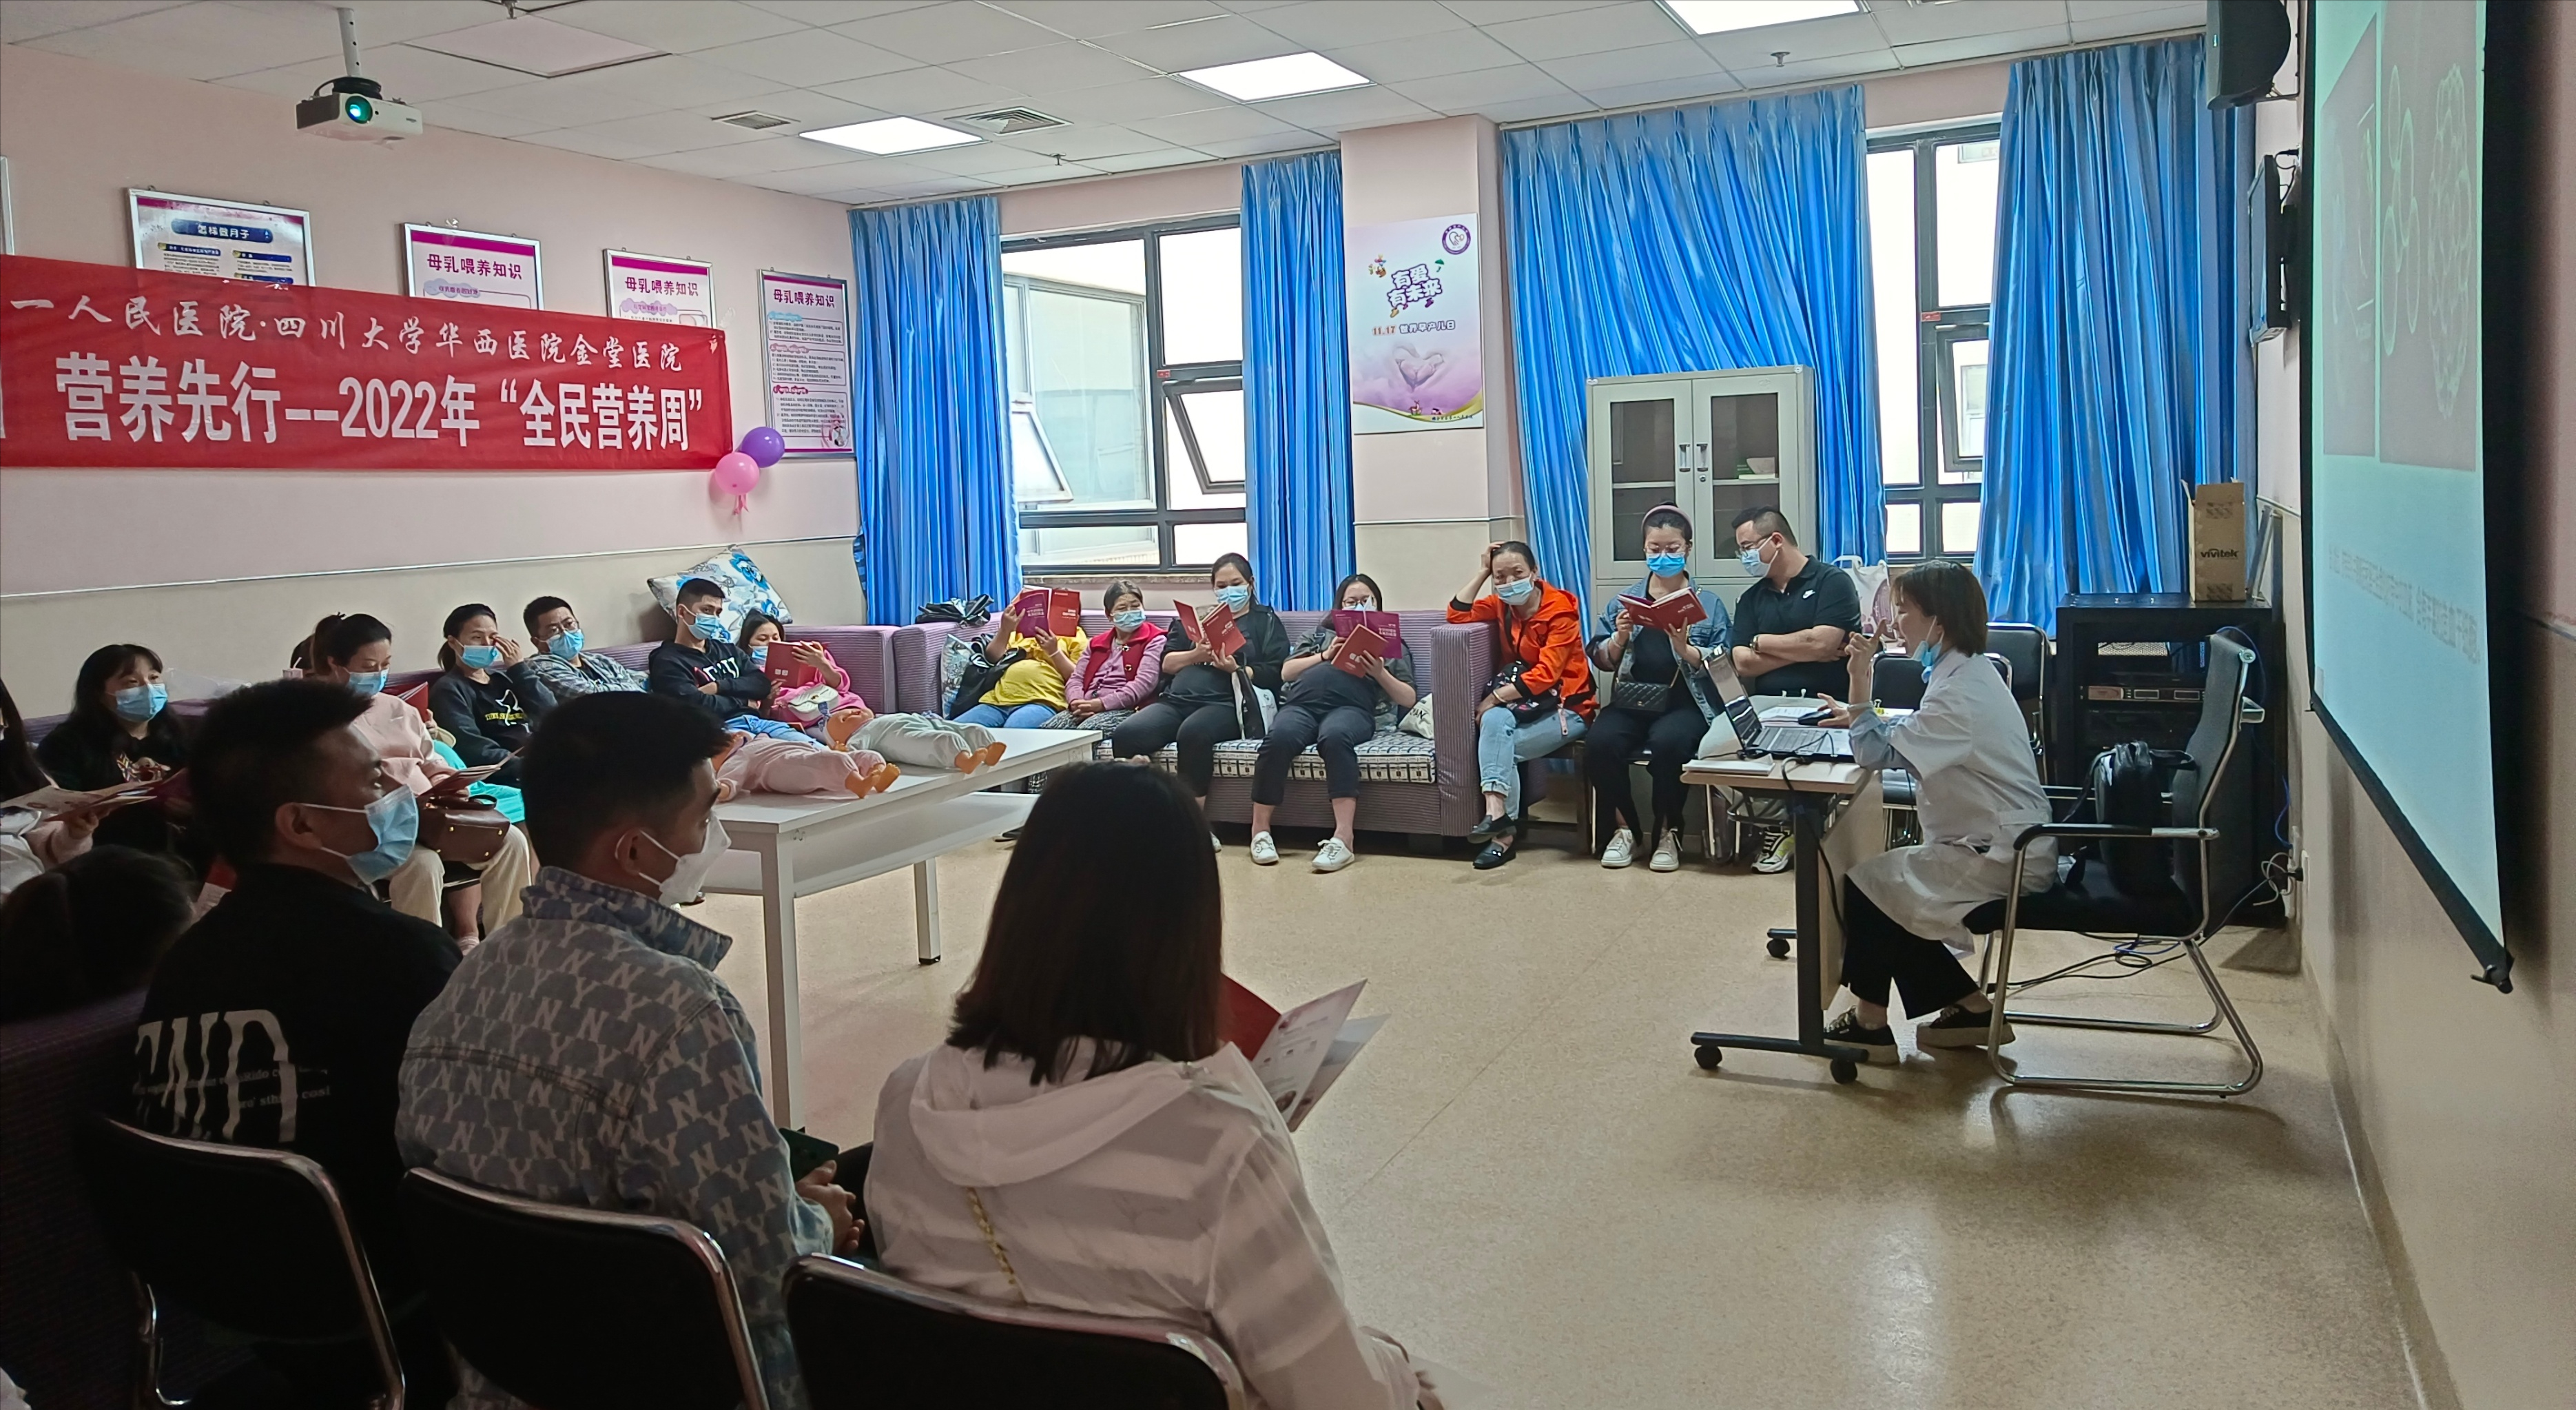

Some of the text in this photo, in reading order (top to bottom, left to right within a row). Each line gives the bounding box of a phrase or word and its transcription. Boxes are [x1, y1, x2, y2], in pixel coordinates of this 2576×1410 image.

[427, 254, 522, 280] 母乳喂养知识
[625, 276, 699, 296] 母乳喂养知识
[1387, 278, 1443, 307] 有未来
[774, 289, 835, 308] 母乳喂养知识
[1372, 320, 1456, 336] 11.17 世界早产儿日
[2201, 549, 2240, 558] vivitek
